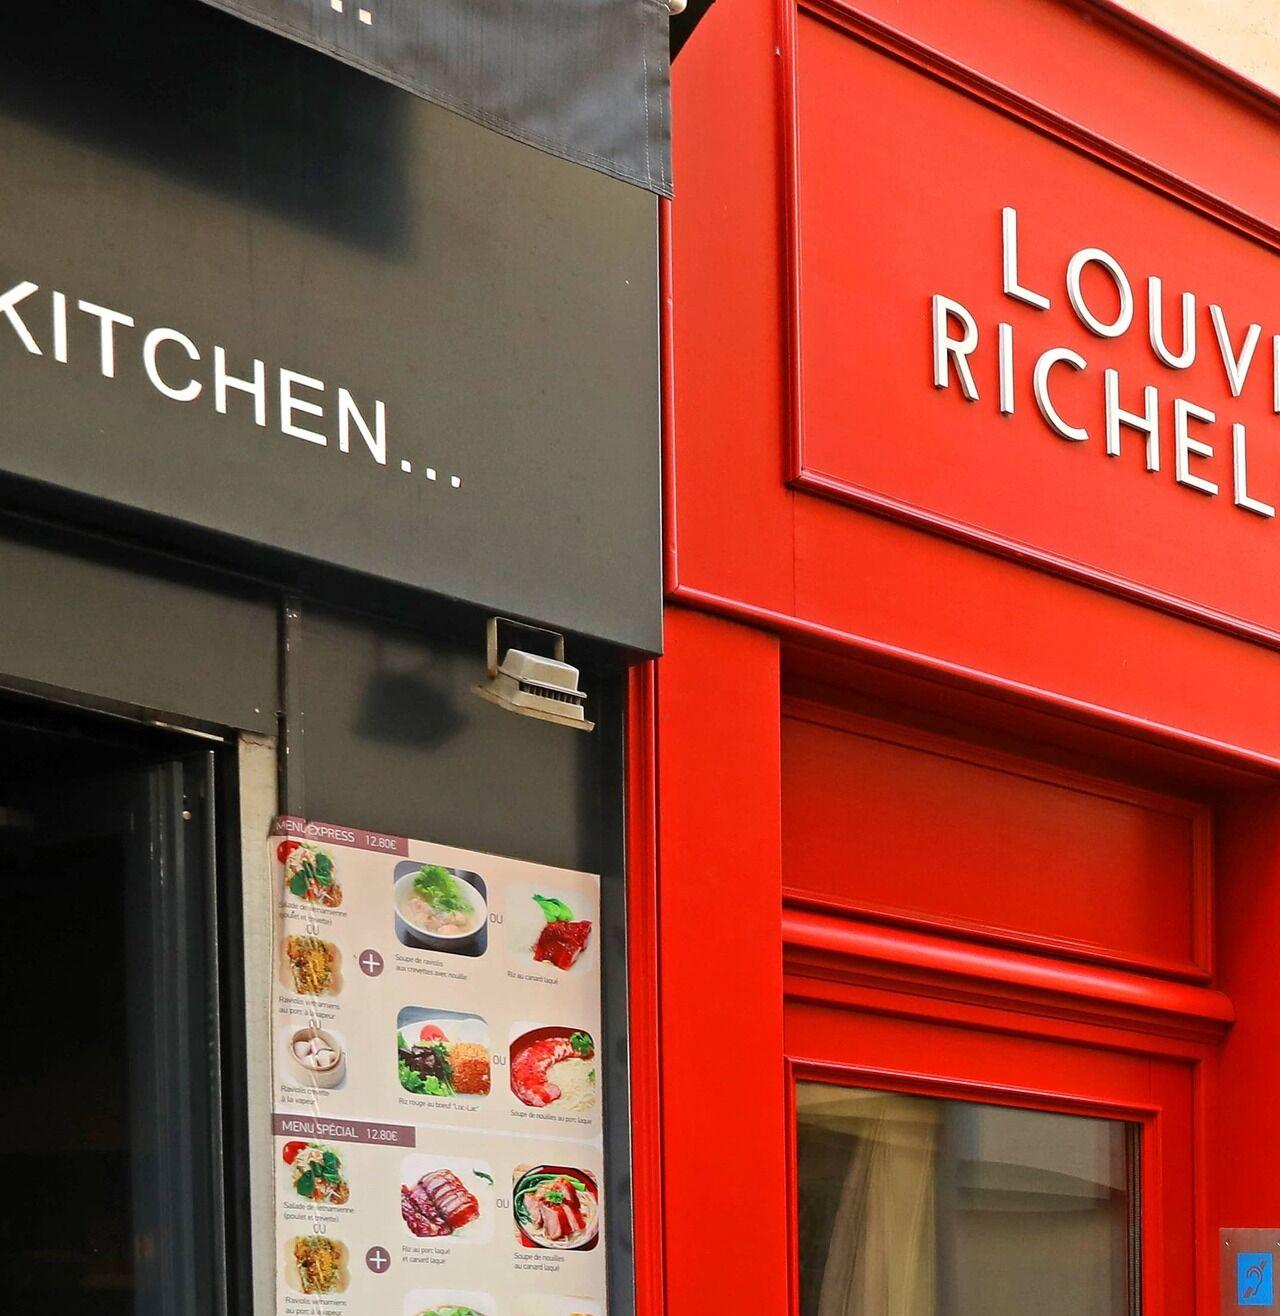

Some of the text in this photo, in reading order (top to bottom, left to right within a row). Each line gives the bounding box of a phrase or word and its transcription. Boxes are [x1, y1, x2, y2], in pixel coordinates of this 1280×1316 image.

[365, 835, 398, 850] 12.80€
[489, 913, 504, 925] OU
[306, 923, 320, 936] OU
[492, 1055, 507, 1066] OU
[282, 1120, 399, 1142] MENU SPÉCIAL 12.80€
[496, 1198, 510, 1210] OU
[313, 1223, 327, 1234] OU
[514, 1252, 532, 1262] Soupe
[534, 1252, 541, 1261] de
